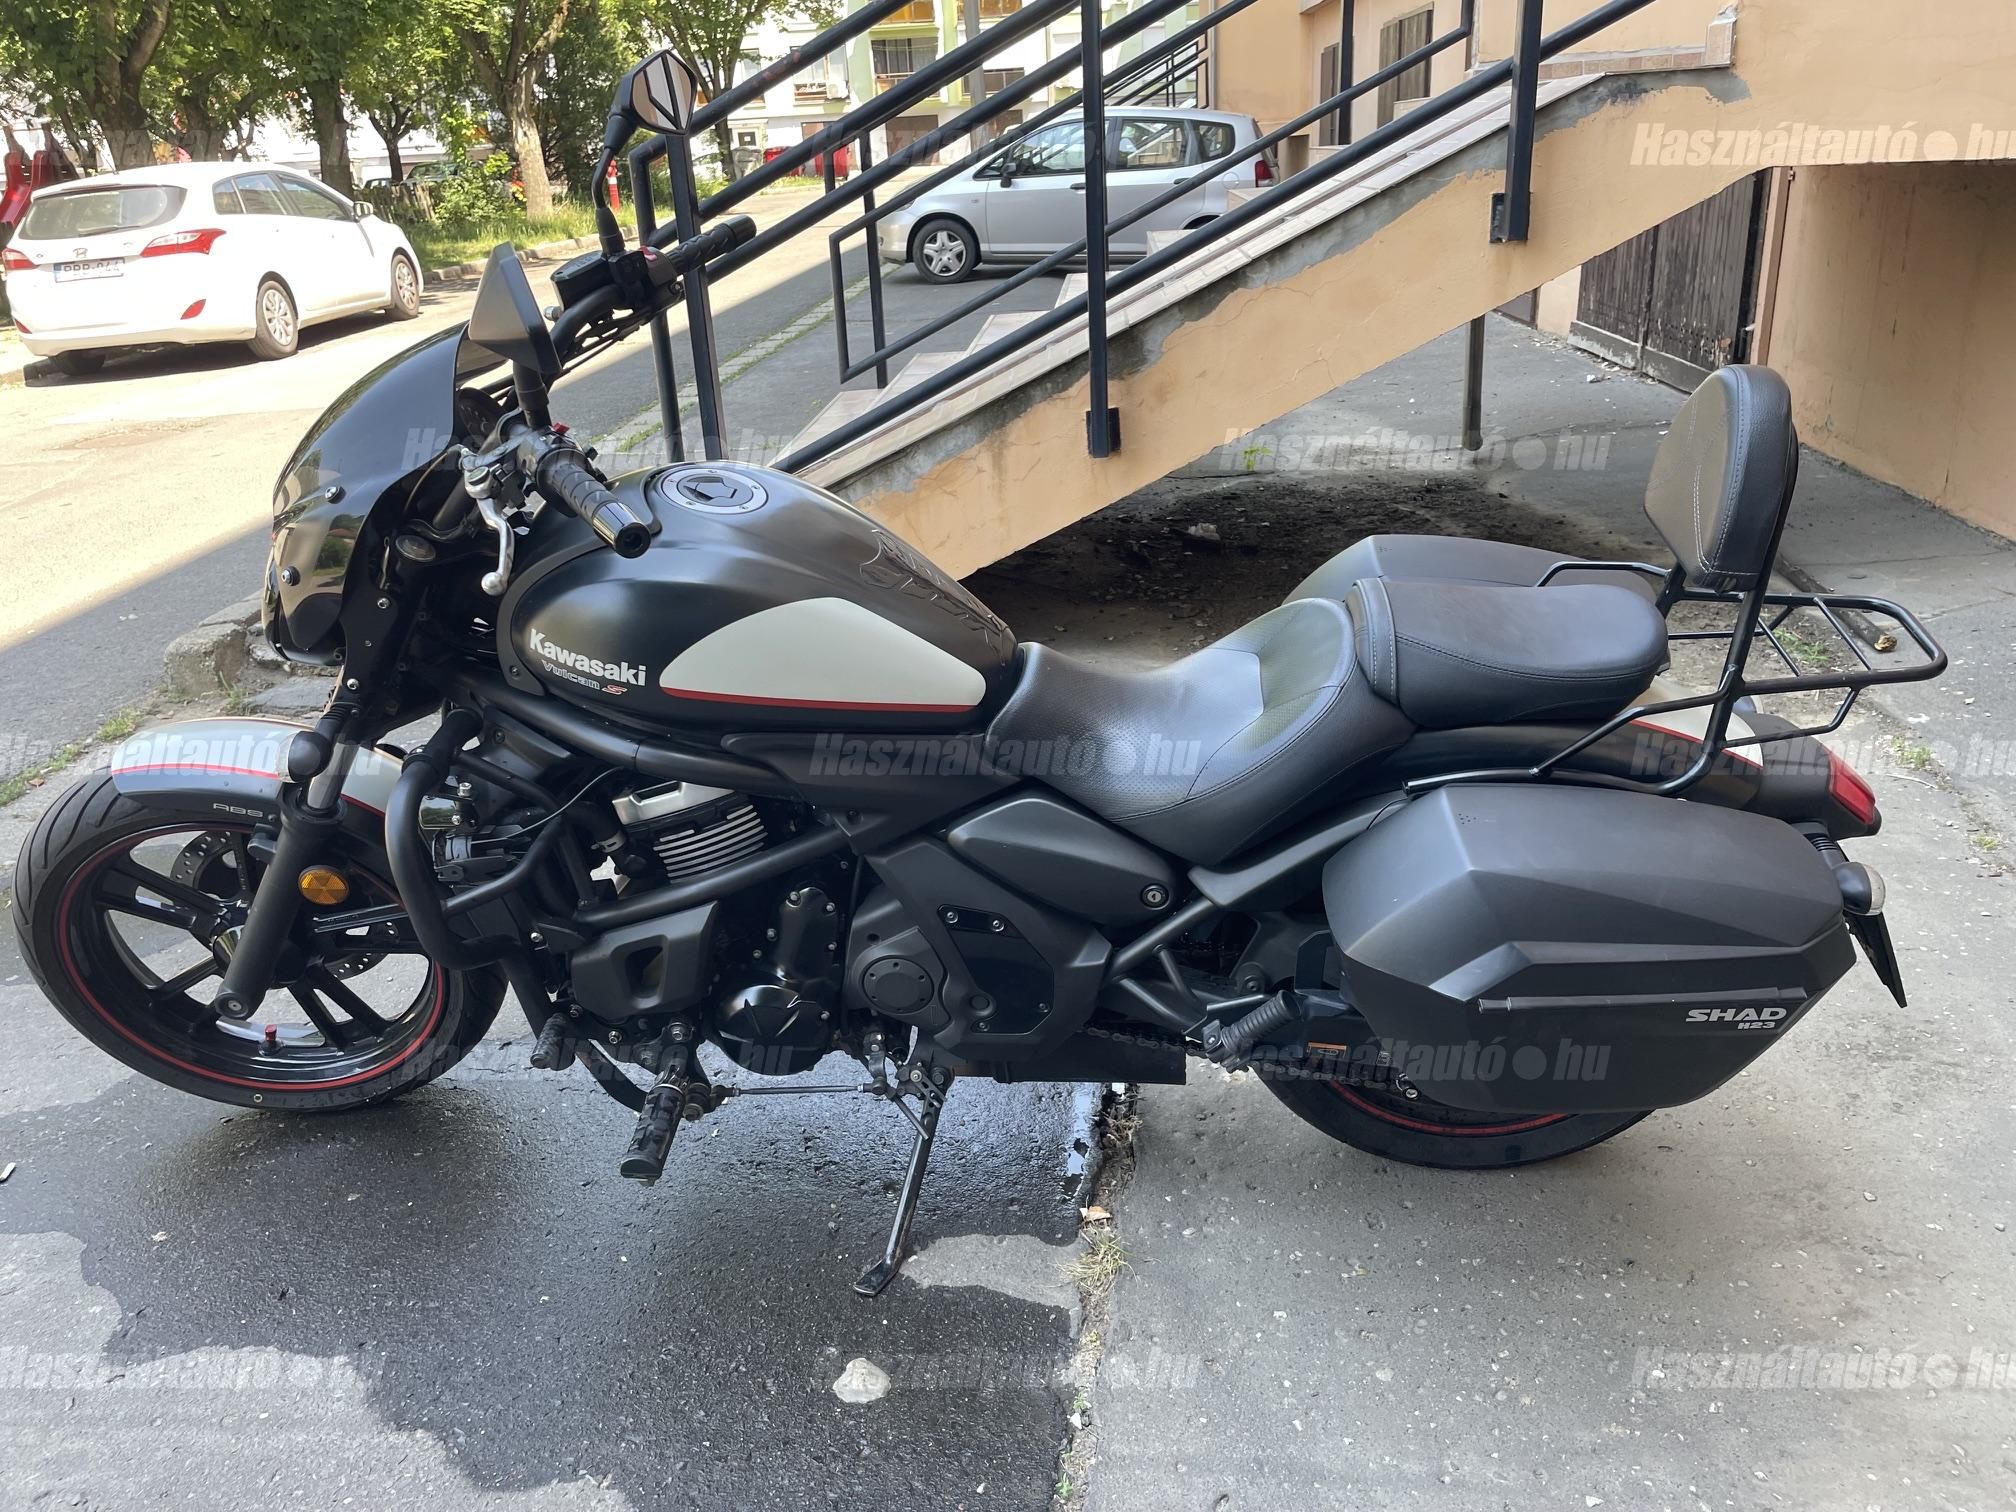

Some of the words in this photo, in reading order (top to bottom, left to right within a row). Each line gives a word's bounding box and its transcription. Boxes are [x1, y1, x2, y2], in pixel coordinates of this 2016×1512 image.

[530, 628, 646, 687] Kawasaki
[541, 659, 600, 691] Vulcan
[213, 803, 264, 818] ABS
[1686, 1007, 1787, 1022] SHAD
[1737, 1021, 1776, 1030] H23
